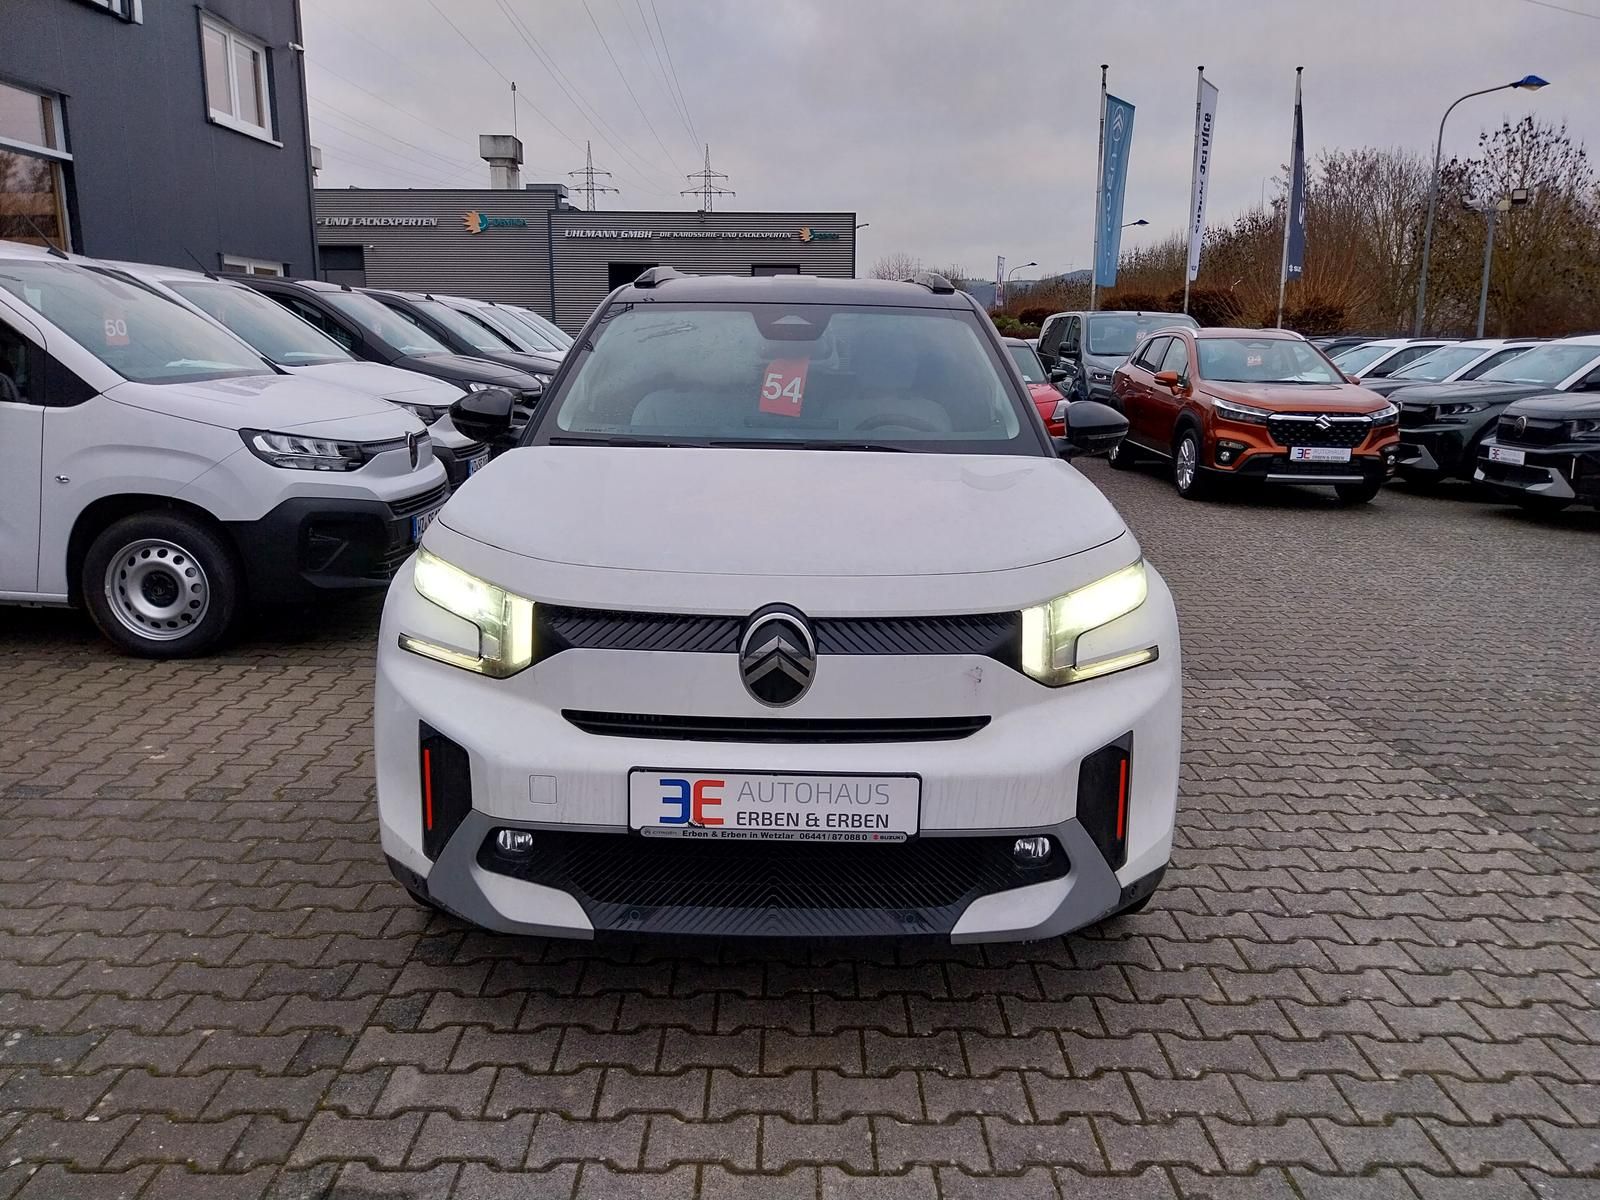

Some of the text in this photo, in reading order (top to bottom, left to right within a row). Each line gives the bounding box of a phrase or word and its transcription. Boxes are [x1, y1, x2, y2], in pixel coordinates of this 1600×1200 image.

[325, 216, 349, 226] UND
[351, 216, 438, 227] LACKEXPERTEN
[564, 229, 619, 238] UHLMANN
[620, 230, 653, 238] GMBH
[738, 231, 792, 239] LACKEXPERTEN
[763, 373, 802, 403] 54
[736, 781, 890, 805] AUTOHAUS
[736, 811, 889, 829] ERBEN & ERBEN
[682, 830, 709, 838] Erben
[721, 831, 748, 839] Erben
[749, 831, 758, 839] in
[760, 831, 795, 840] Wetzlar
